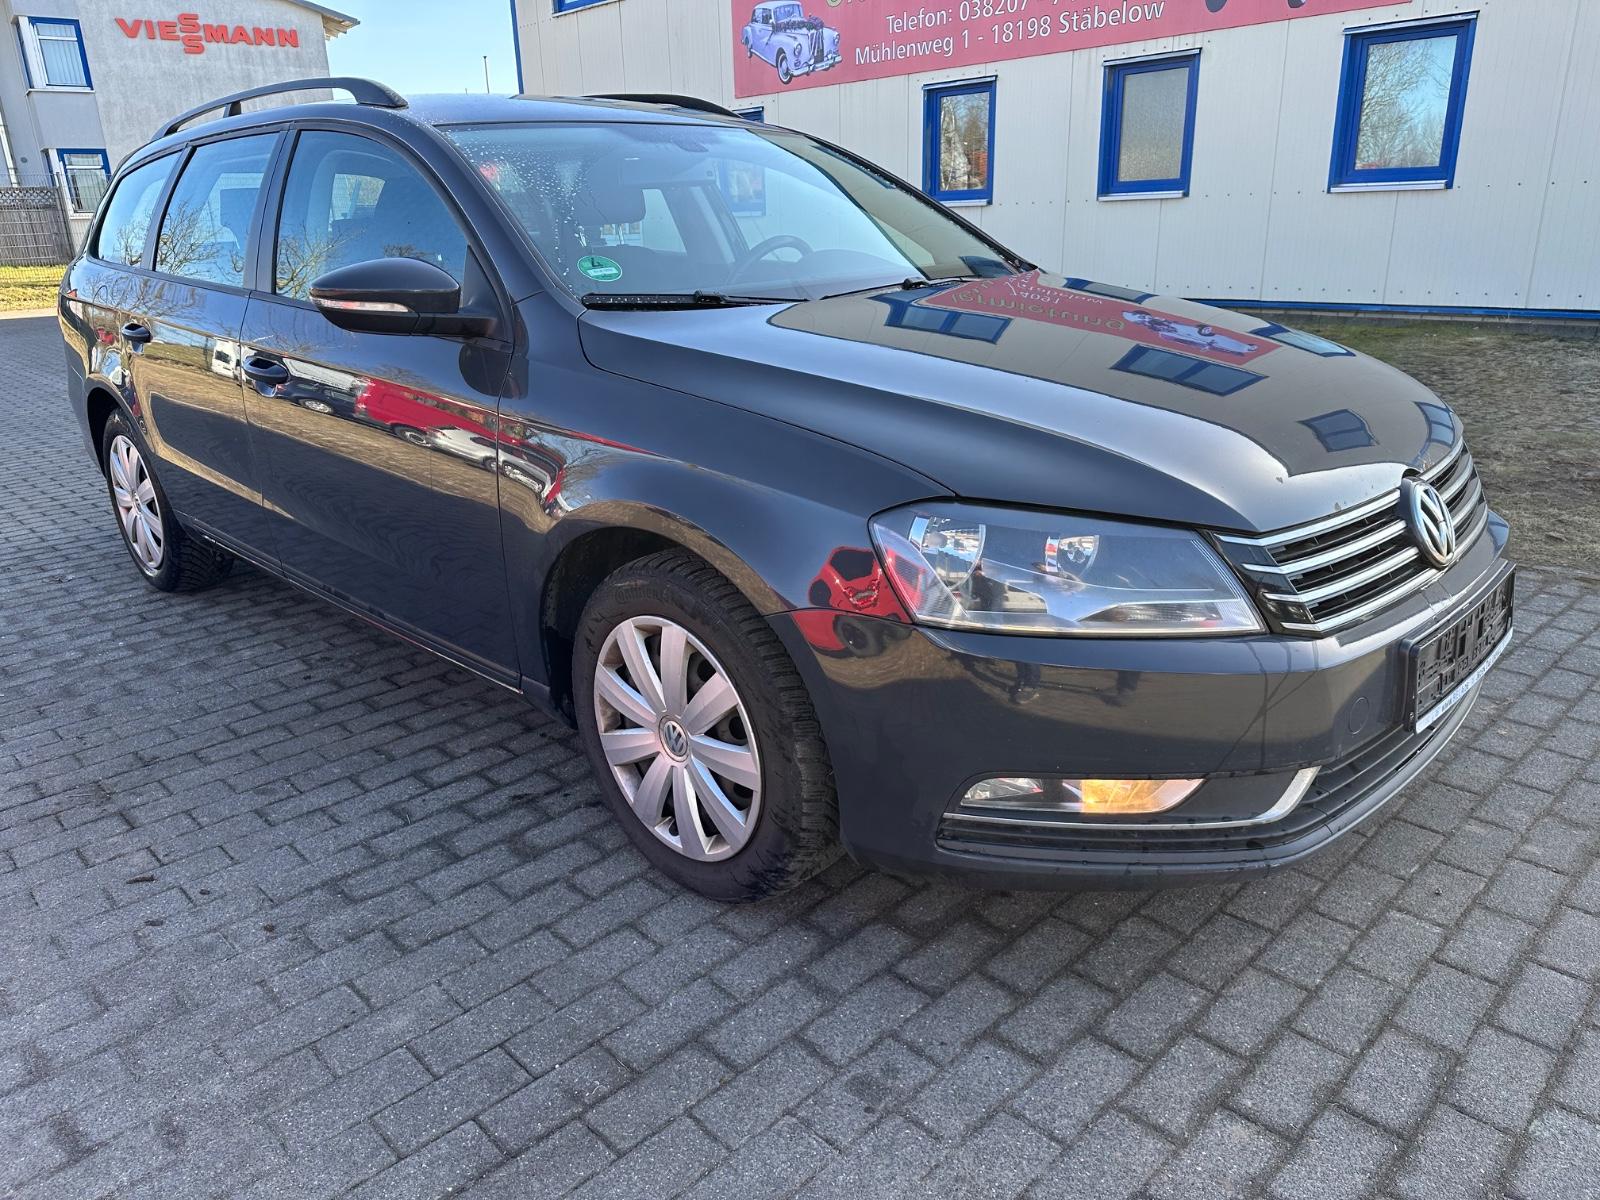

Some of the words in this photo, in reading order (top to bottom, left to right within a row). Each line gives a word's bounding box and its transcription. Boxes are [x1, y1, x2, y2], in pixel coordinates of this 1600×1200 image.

[115, 13, 299, 55] VIESSMANN
[855, 36, 954, 65] Mühlenweg
[961, 29, 970, 49] 1
[991, 15, 1051, 44] 18198
[1058, 1, 1165, 34] Stäbelow
[886, 8, 953, 35] Telefon:
